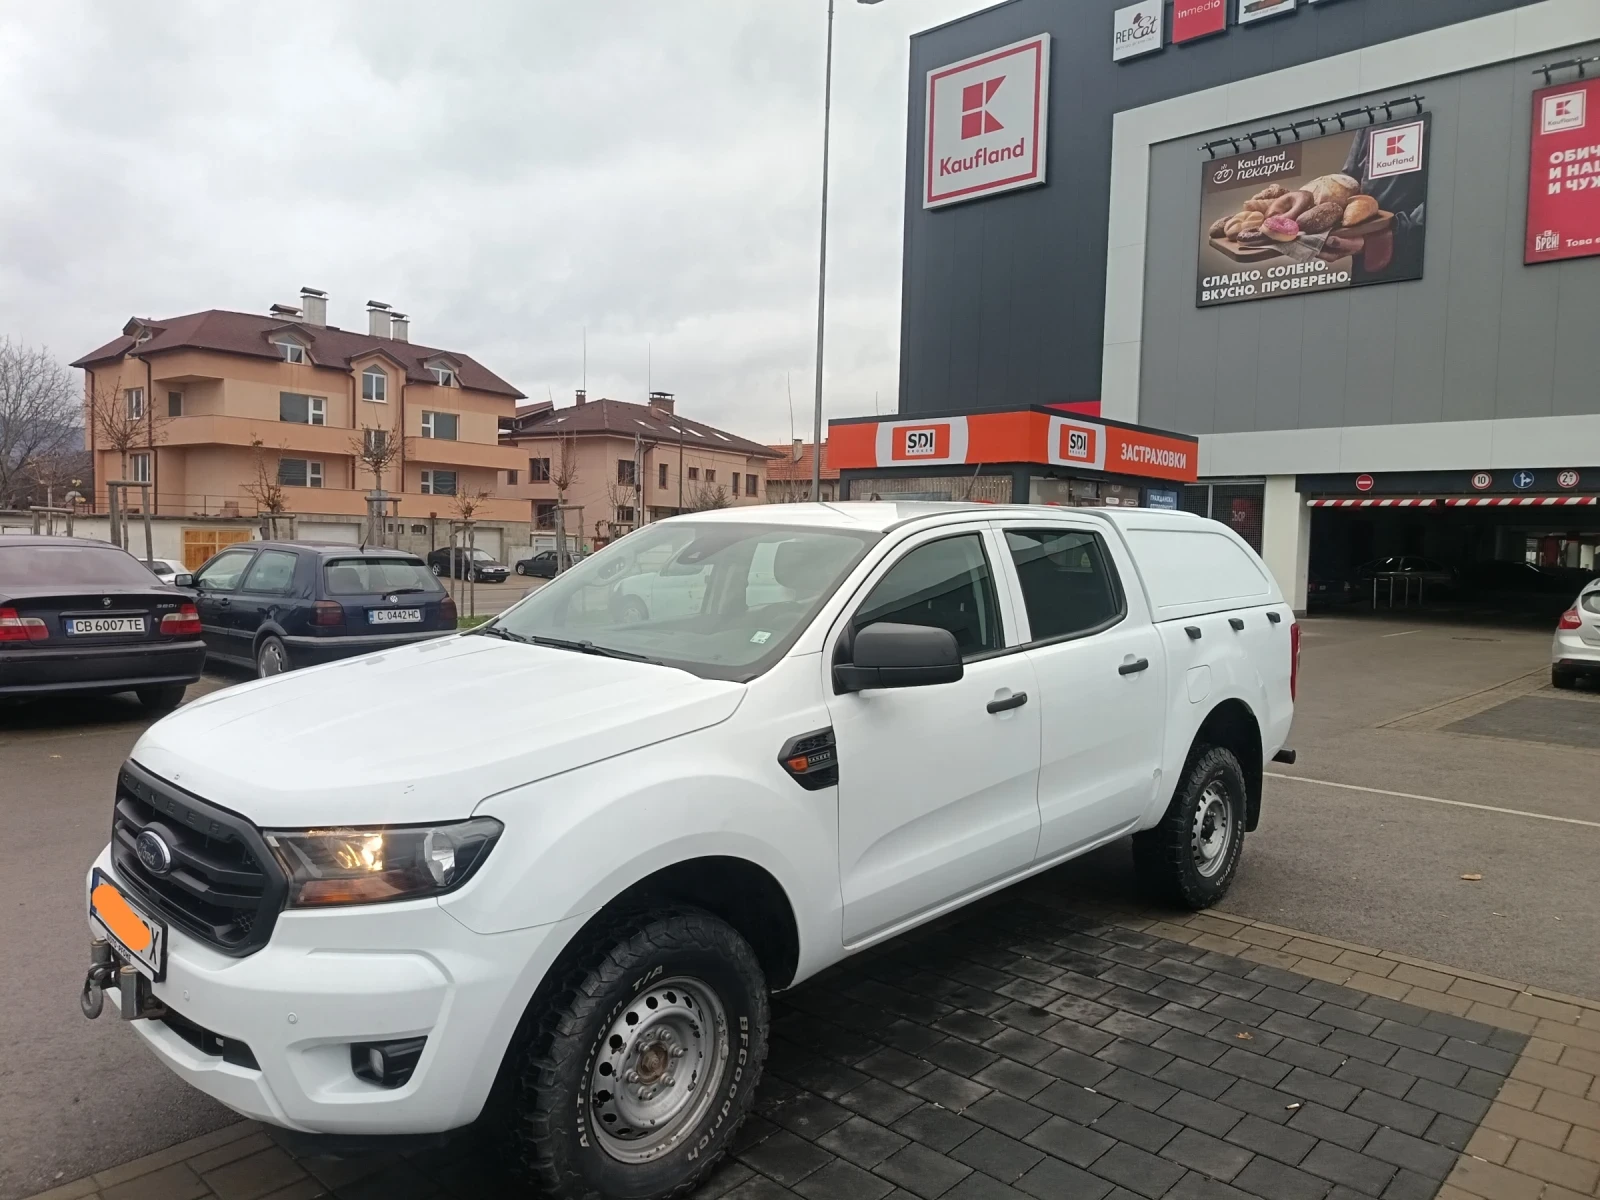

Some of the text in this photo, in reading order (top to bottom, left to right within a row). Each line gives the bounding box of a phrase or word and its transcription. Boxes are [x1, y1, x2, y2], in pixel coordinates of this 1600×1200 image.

[1177, 0, 1221, 19] inmedio
[939, 137, 1025, 177] Kaufland
[1237, 150, 1285, 169] Kaufland
[1376, 155, 1415, 170] Kaufland
[1236, 158, 1296, 181] пекарна
[1548, 167, 1562, 180] И
[1547, 181, 1561, 195] И
[1565, 237, 1593, 248] Това
[1202, 260, 1329, 288] СЛАДКО. СОЛЕНО.
[1201, 272, 1352, 302] ВКУСНО. ПРОВЕРЕНО.
[907, 432, 934, 449] SDI
[1069, 433, 1087, 451] SDI
[1120, 442, 1187, 469] ЗАСТРАХОВКИ
[1477, 475, 1486, 485] 10
[387, 610, 407, 620] 0442
[408, 610, 419, 619] HC
[75, 618, 143, 633] CB 6007 TE
[138, 840, 156, 866] Ford
[632, 965, 664, 992] T/A
[687, 1016, 749, 1162] BFGoodrich
